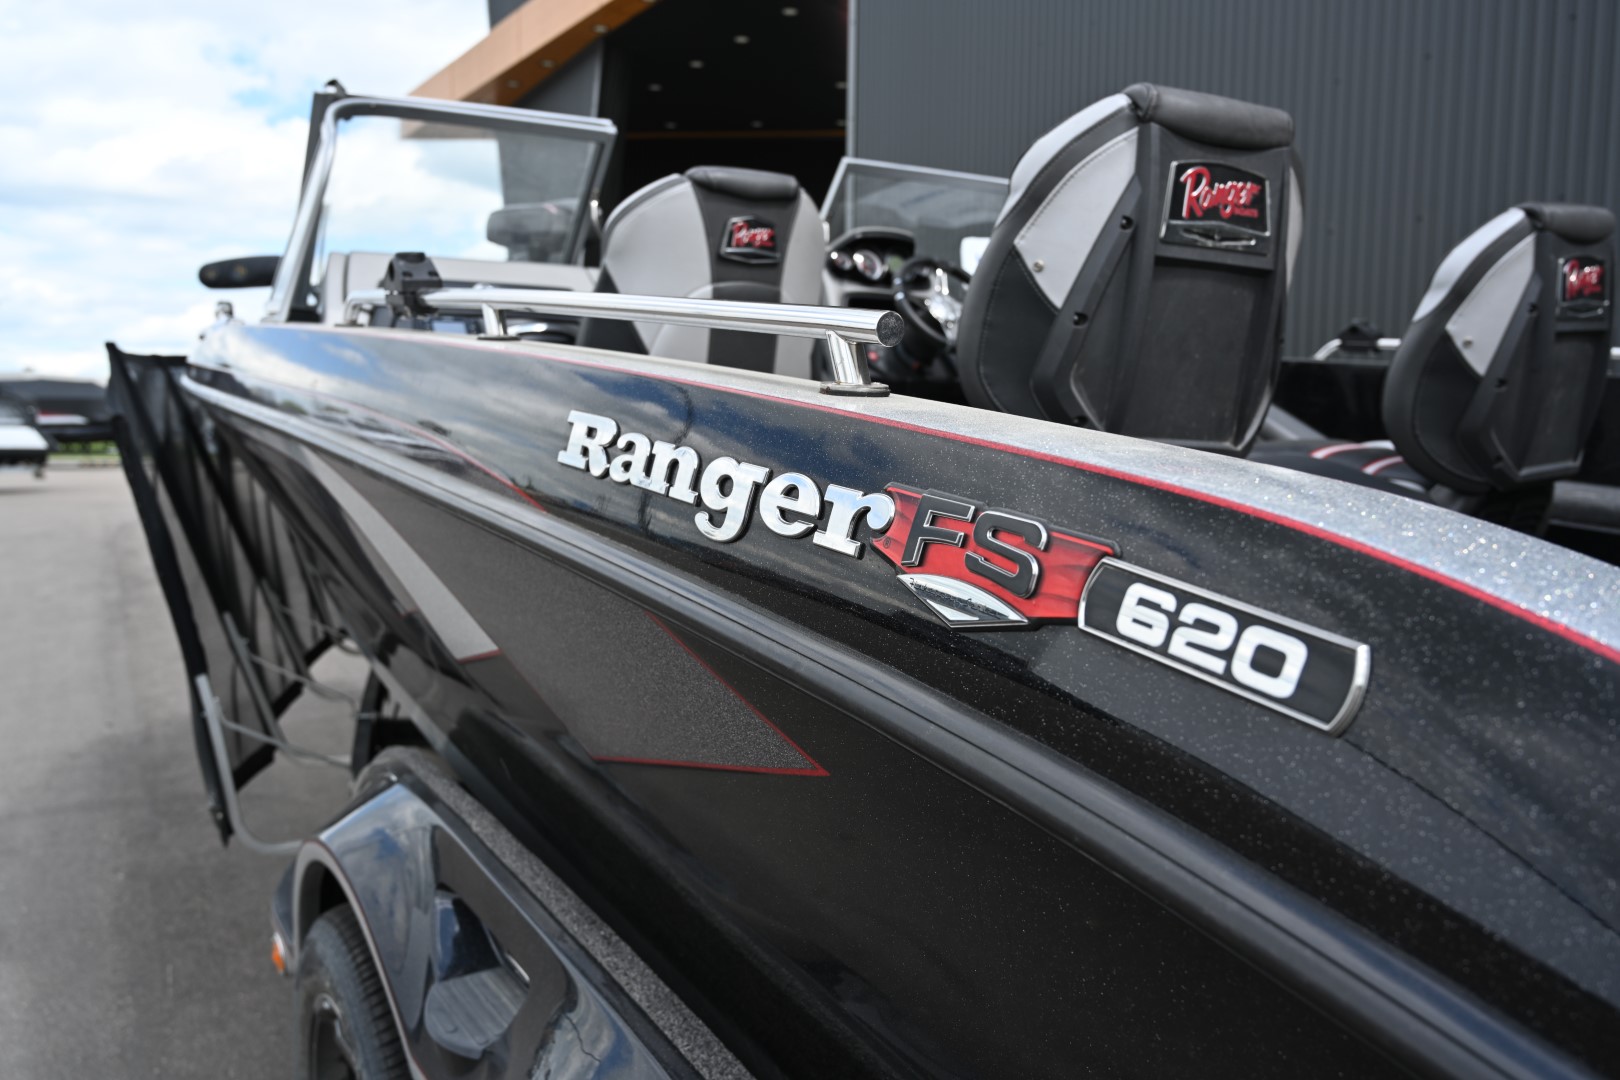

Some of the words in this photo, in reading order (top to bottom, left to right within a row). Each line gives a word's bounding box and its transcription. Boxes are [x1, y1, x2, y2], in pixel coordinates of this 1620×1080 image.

[556, 409, 895, 559] Ranger
[900, 493, 1048, 599] FS
[1116, 582, 1308, 699] 620
